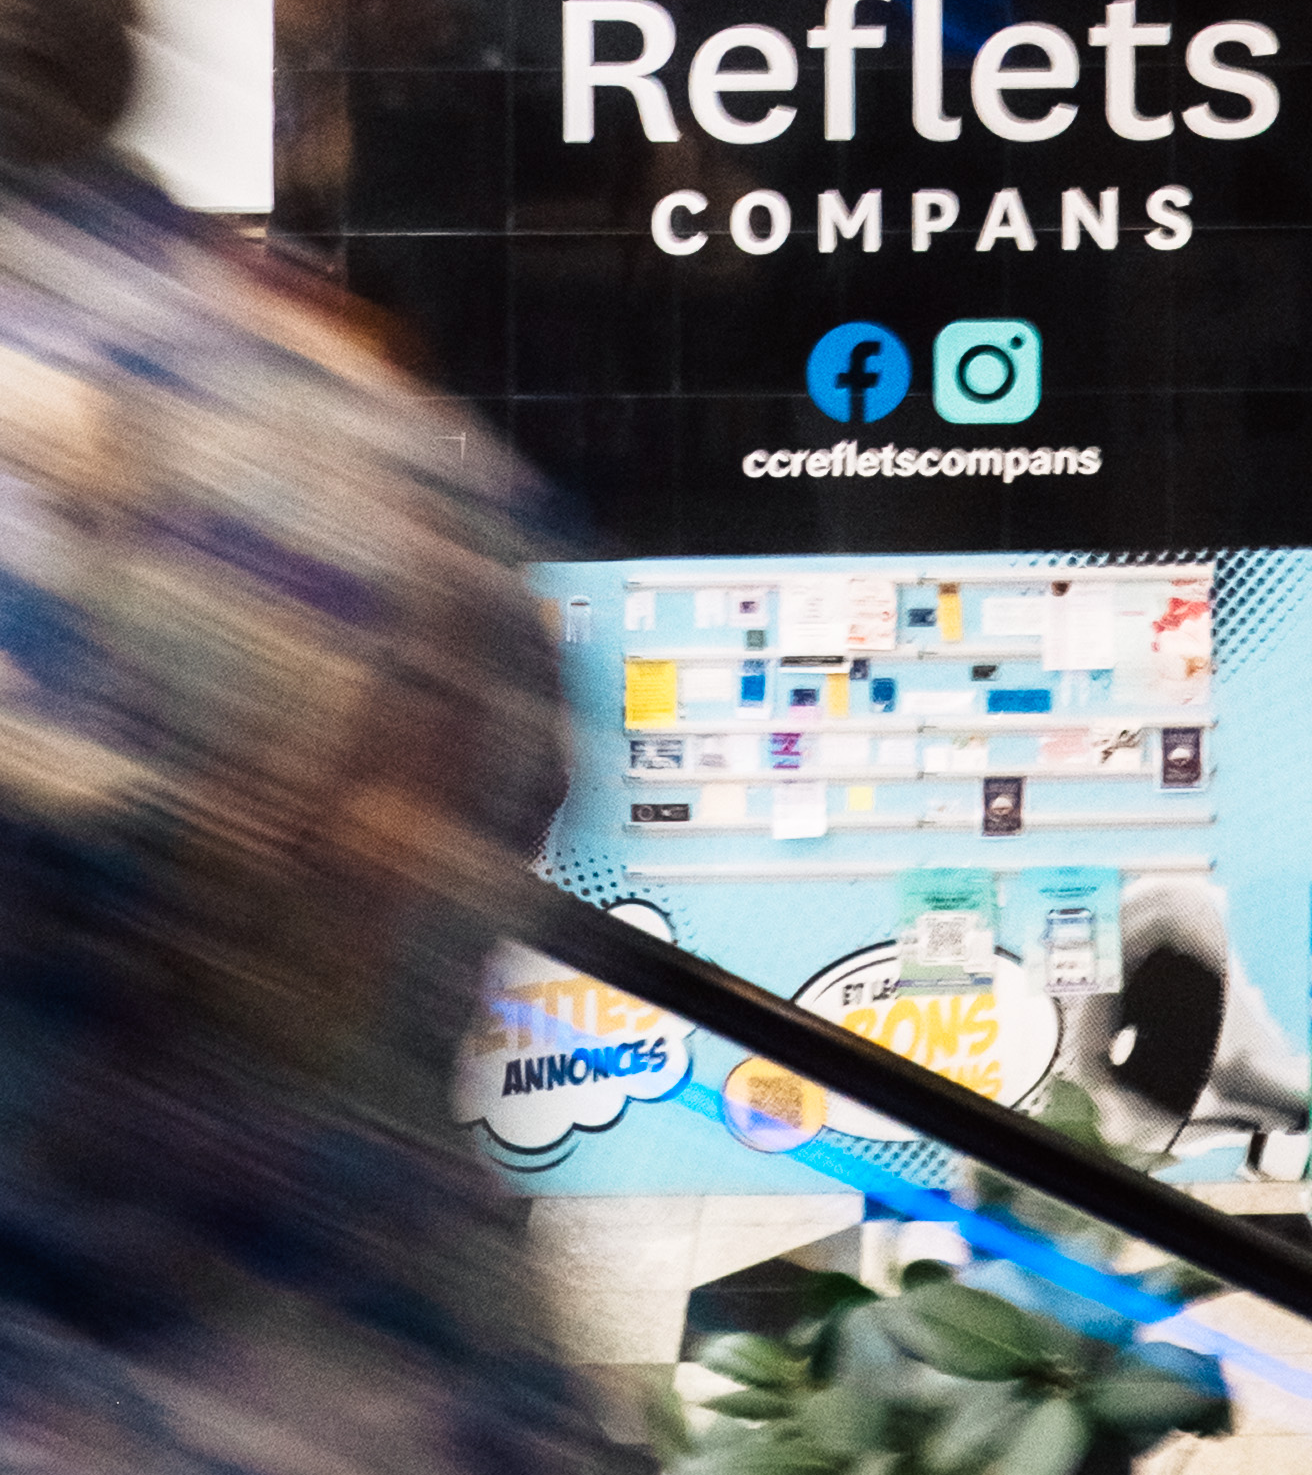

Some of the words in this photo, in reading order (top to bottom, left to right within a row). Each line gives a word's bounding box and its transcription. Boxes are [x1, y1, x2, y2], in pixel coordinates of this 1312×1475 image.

[650, 183, 1195, 256] COMPANS
[741, 439, 1103, 484] ccrefletscompans
[500, 1035, 668, 1098] ANNONCES
